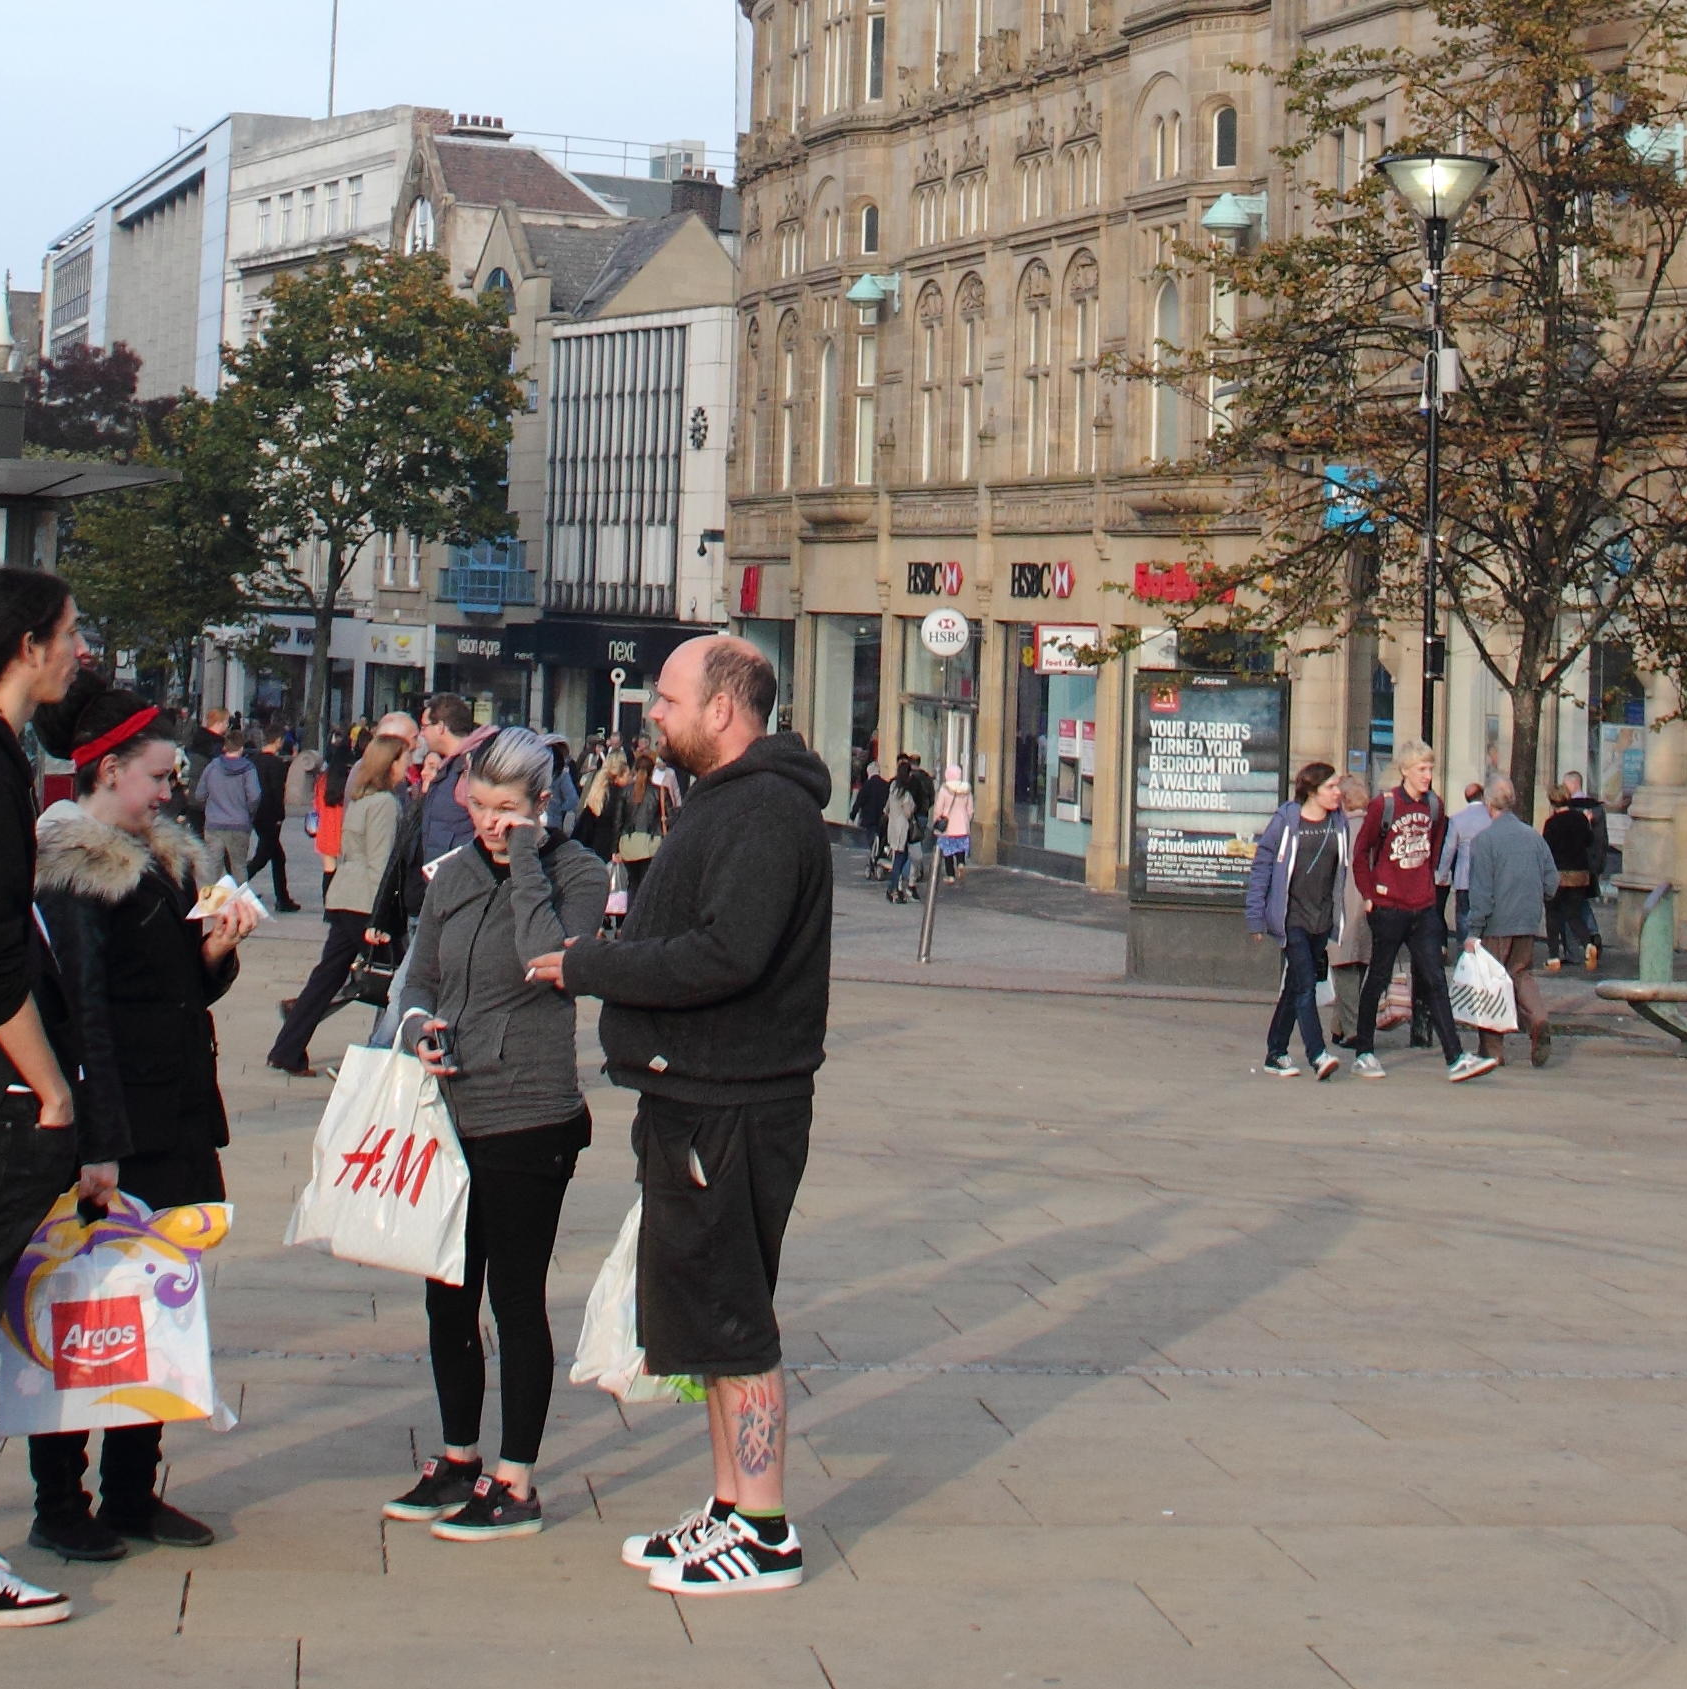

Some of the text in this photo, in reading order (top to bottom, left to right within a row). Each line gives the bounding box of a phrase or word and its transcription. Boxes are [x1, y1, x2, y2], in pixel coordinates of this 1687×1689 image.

[907, 562, 943, 595] HSBC
[1010, 562, 1051, 598] HSBC
[457, 634, 479, 654] vision
[928, 630, 965, 643] HSBC
[608, 640, 637, 663] next
[1150, 720, 1251, 740] YOUR PARENTS
[1150, 737, 1243, 758] TURNED YOUR
[1149, 755, 1250, 775] BEDROOM INTO
[1149, 773, 1222, 792] A WALK-IN
[1149, 791, 1231, 811] WARDROBE.
[1148, 828, 1184, 838] Time for a
[1147, 837, 1227, 855] #studentWIN
[334, 1124, 439, 1207] H&M
[60, 1323, 137, 1355] Argos
